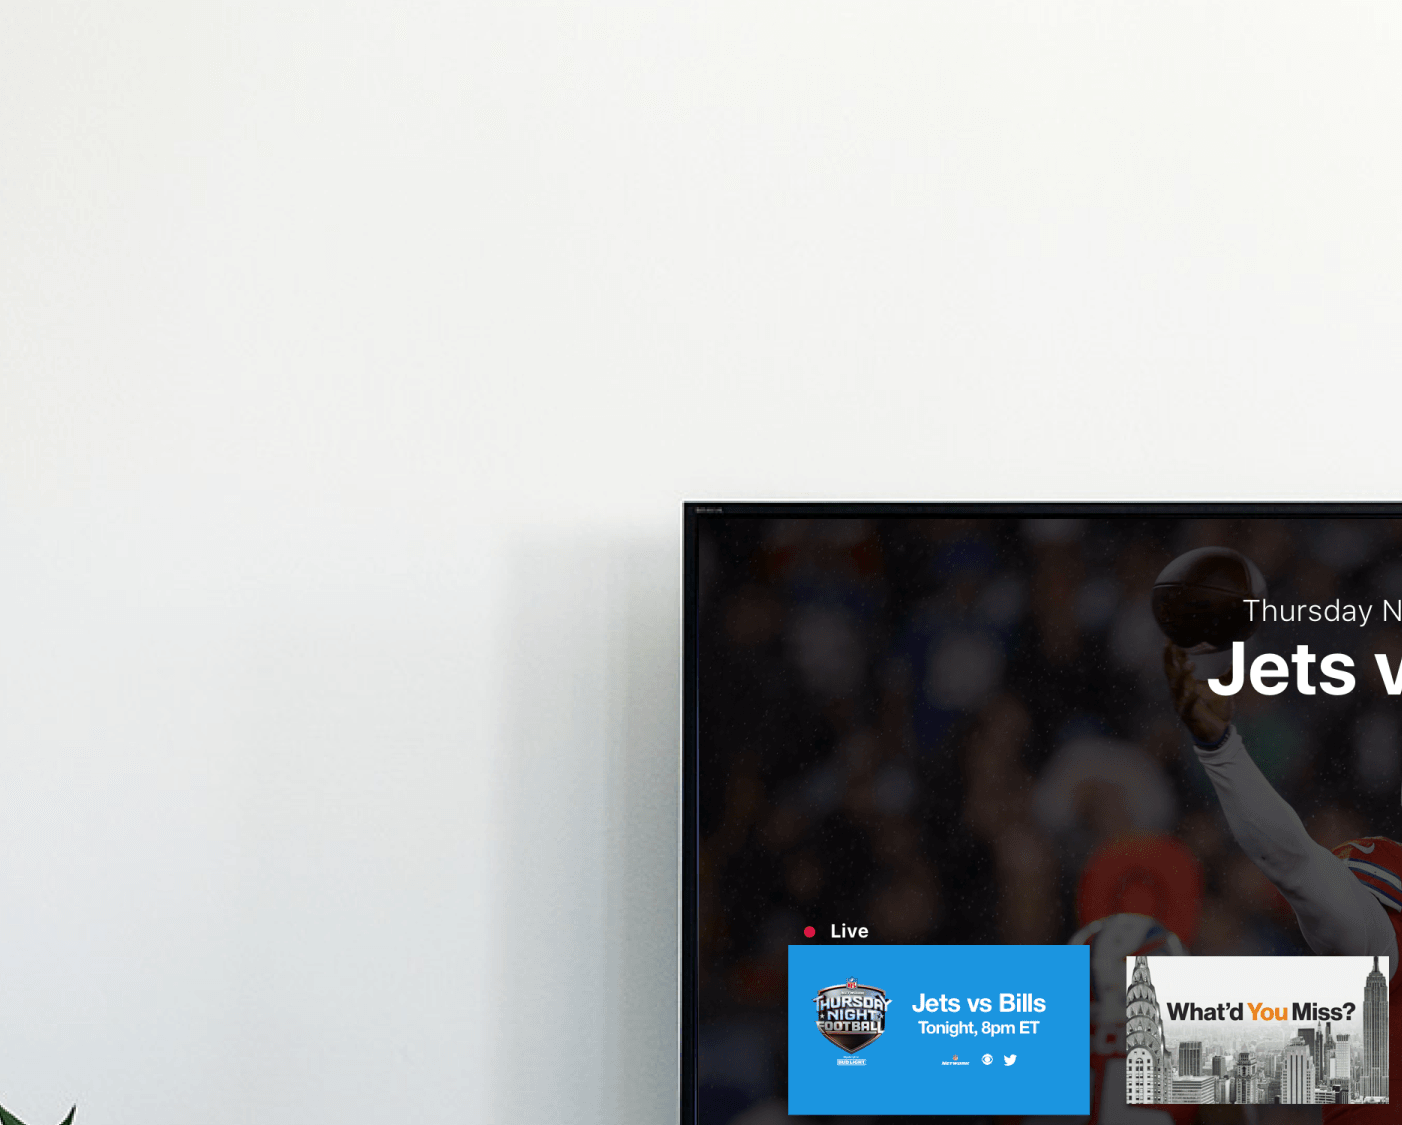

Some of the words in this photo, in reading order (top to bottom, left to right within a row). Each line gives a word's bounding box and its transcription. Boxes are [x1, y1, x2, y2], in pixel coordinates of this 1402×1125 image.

[1243, 598, 1373, 628] Thursday
[1208, 641, 1356, 697] Jets
[831, 923, 869, 939] Live
[812, 995, 893, 1012] THURSDAY
[912, 993, 961, 1013] Jets
[967, 997, 993, 1013] vs
[999, 993, 1047, 1013] Bills
[828, 1009, 877, 1021] NIGHT
[1247, 1003, 1288, 1021] You
[1292, 1003, 1356, 1021] Miss?
[815, 1021, 885, 1034] FOOTBALL
[918, 1021, 978, 1038] Tonight,
[981, 1021, 1016, 1038] 8pm
[1019, 1021, 1041, 1035] ET
